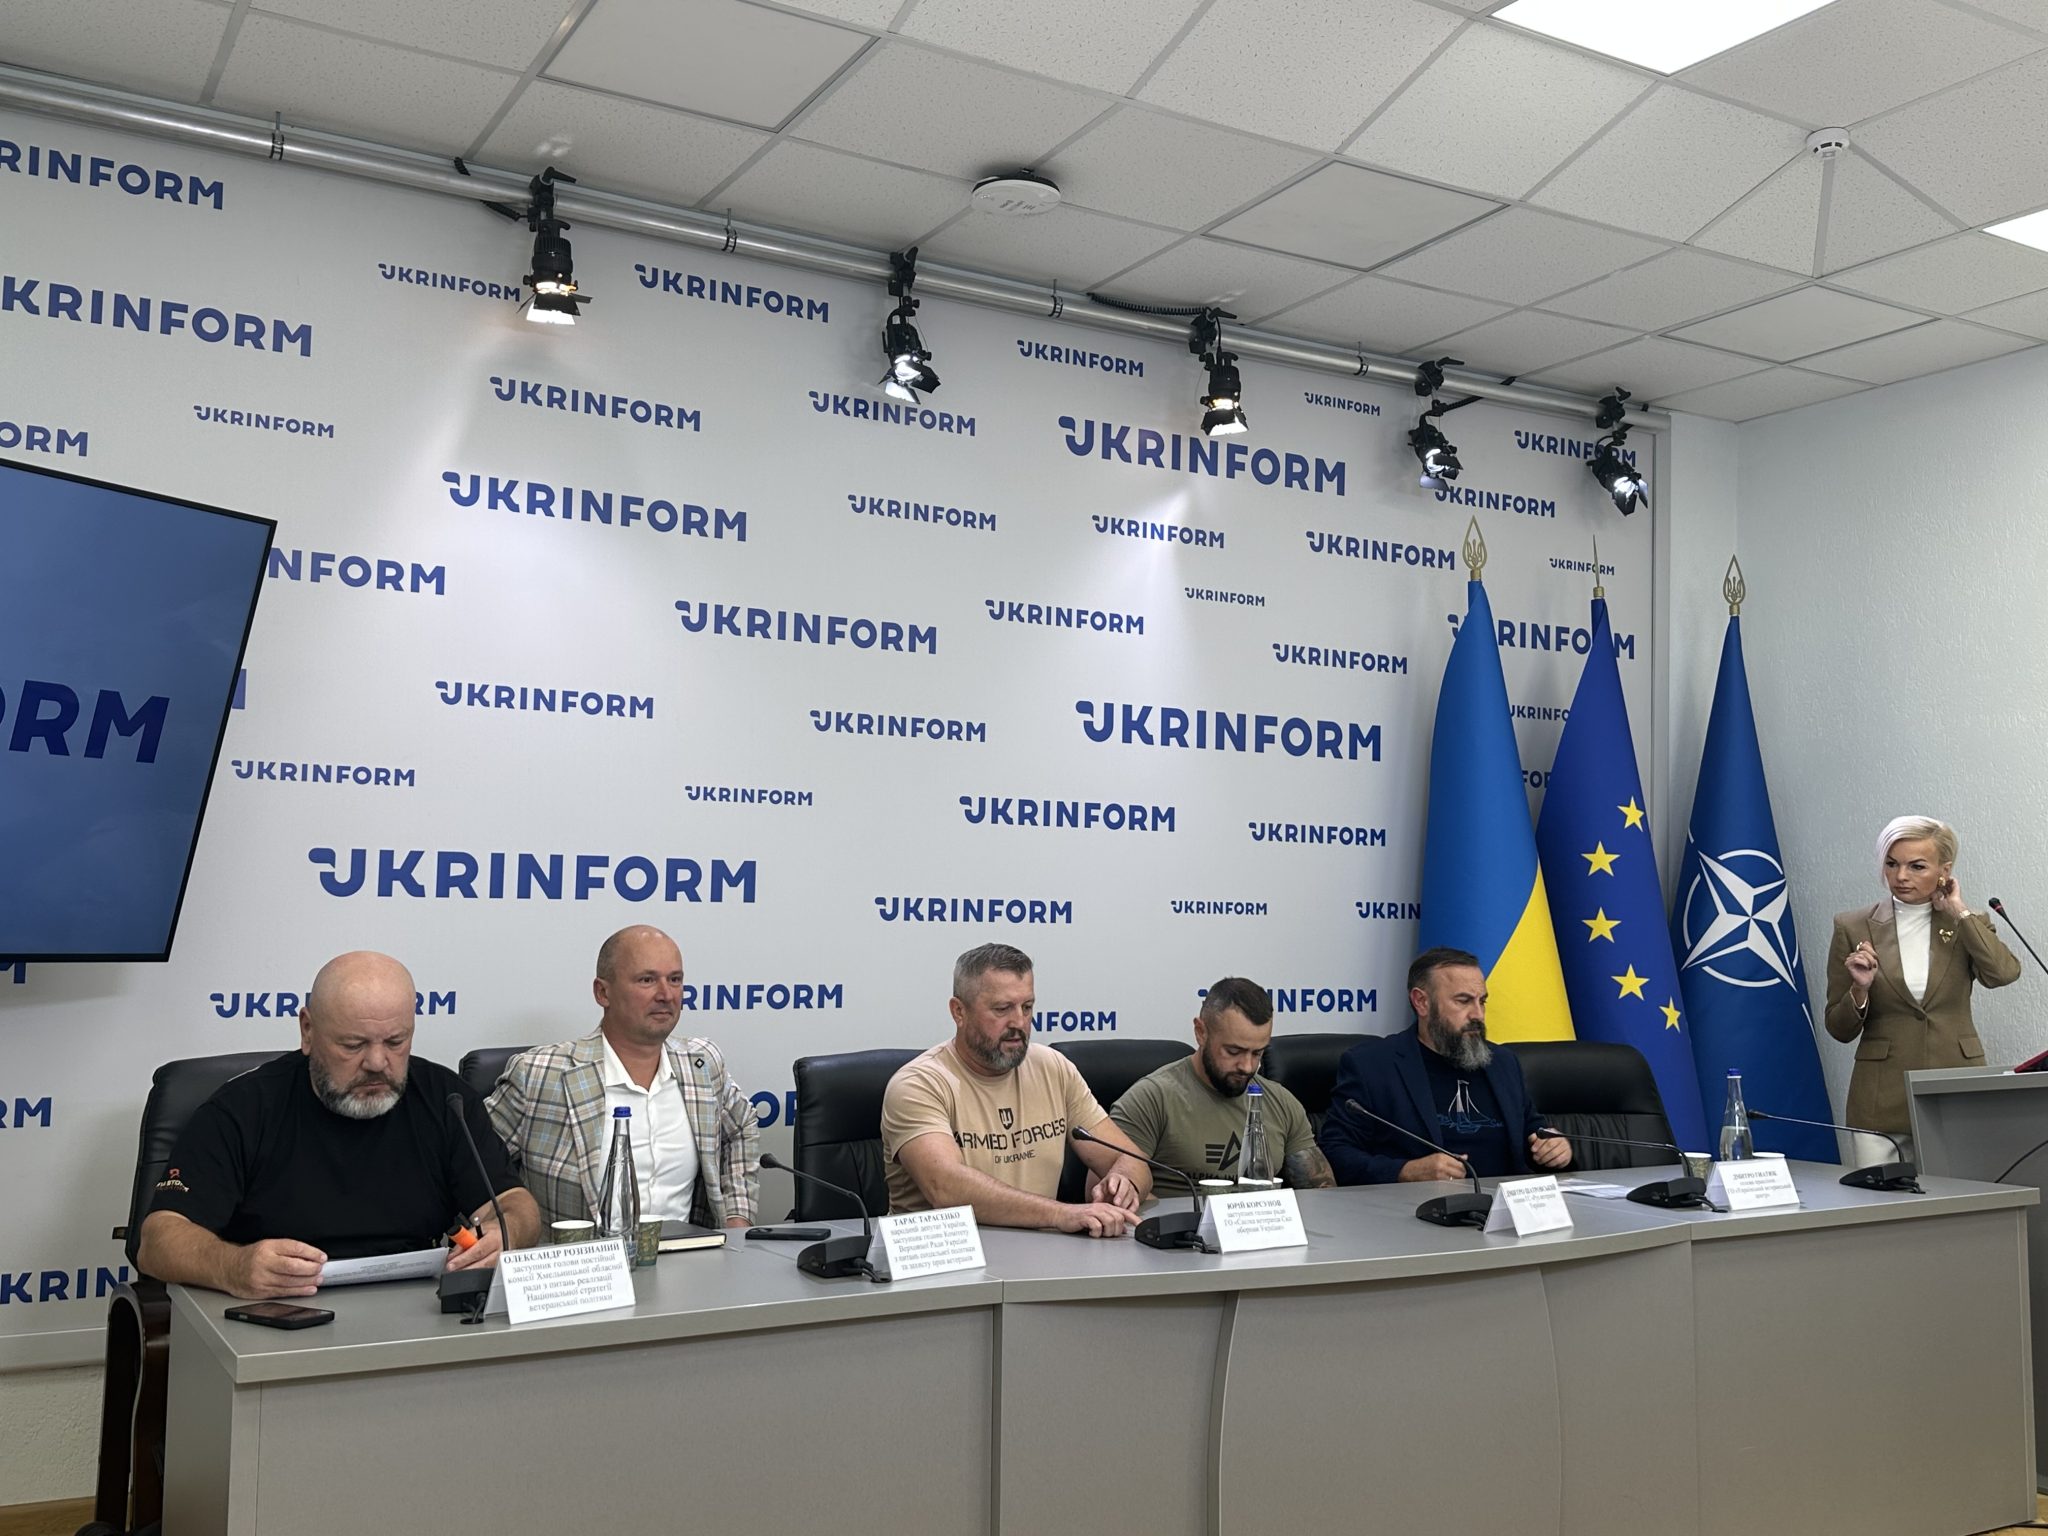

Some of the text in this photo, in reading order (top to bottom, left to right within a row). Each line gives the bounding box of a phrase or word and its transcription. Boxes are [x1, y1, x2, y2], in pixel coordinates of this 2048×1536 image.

[378, 263, 521, 302] UKRINFORM
[634, 263, 829, 324] UKRINFORM
[2, 276, 312, 357] KRINFORM
[1018, 339, 1144, 376] UKRINFORM
[490, 376, 702, 433] UKRINFORM
[808, 390, 977, 437] UKRINFORM
[1305, 391, 1381, 416] UKRINFORM
[193, 404, 335, 440] UKRINFORM
[1058, 415, 1346, 498] UKRINFORM
[441, 470, 748, 542] UKRINFORM
[847, 493, 997, 531] UKRINFORM
[1092, 515, 1225, 548] UKRINFORM
[1306, 529, 1456, 571] UKRINFORM
[1184, 586, 1266, 608] UKRINFORM
[675, 599, 937, 656] UKRINFORM
[984, 599, 1144, 637] UKRINFORM
[1447, 613, 1636, 660] RINFOM
[1272, 642, 1409, 676] UKRINFORM
[435, 680, 655, 720] UKRINFORM
[809, 709, 987, 744] UKRINFORM
[1075, 700, 1382, 764] UKRINFORM
[231, 759, 416, 788] UKRINFORM
[685, 785, 814, 807] UKRINFORM
[959, 795, 1176, 833] UKRINFORM
[1248, 821, 1387, 848] UKRINFORM
[308, 847, 757, 904] UKRINFORM
[874, 896, 1073, 925] UKRINFORM
[1170, 899, 1268, 917] UKRINFORM
[953, 1117, 1066, 1150] ARMED FORCES
[994, 1149, 1036, 1164] OF UKRAINE
[894, 1212, 960, 1226] ТАРАС ТАРАСЕНКО
[504, 1243, 620, 1264] ОЛЕКСАНДР РОЗІЗНАНИЙ
[513, 1262, 552, 1275] заступник
[553, 1260, 579, 1269] голови
[536, 1267, 590, 1280] Хмельницької
[592, 1262, 623, 1273] обласної
[523, 1284, 541, 1294] ради
[549, 1280, 576, 1289] питань
[527, 1283, 612, 1302] Національної стратегії
[529, 1294, 613, 1312] ветеранської політики
